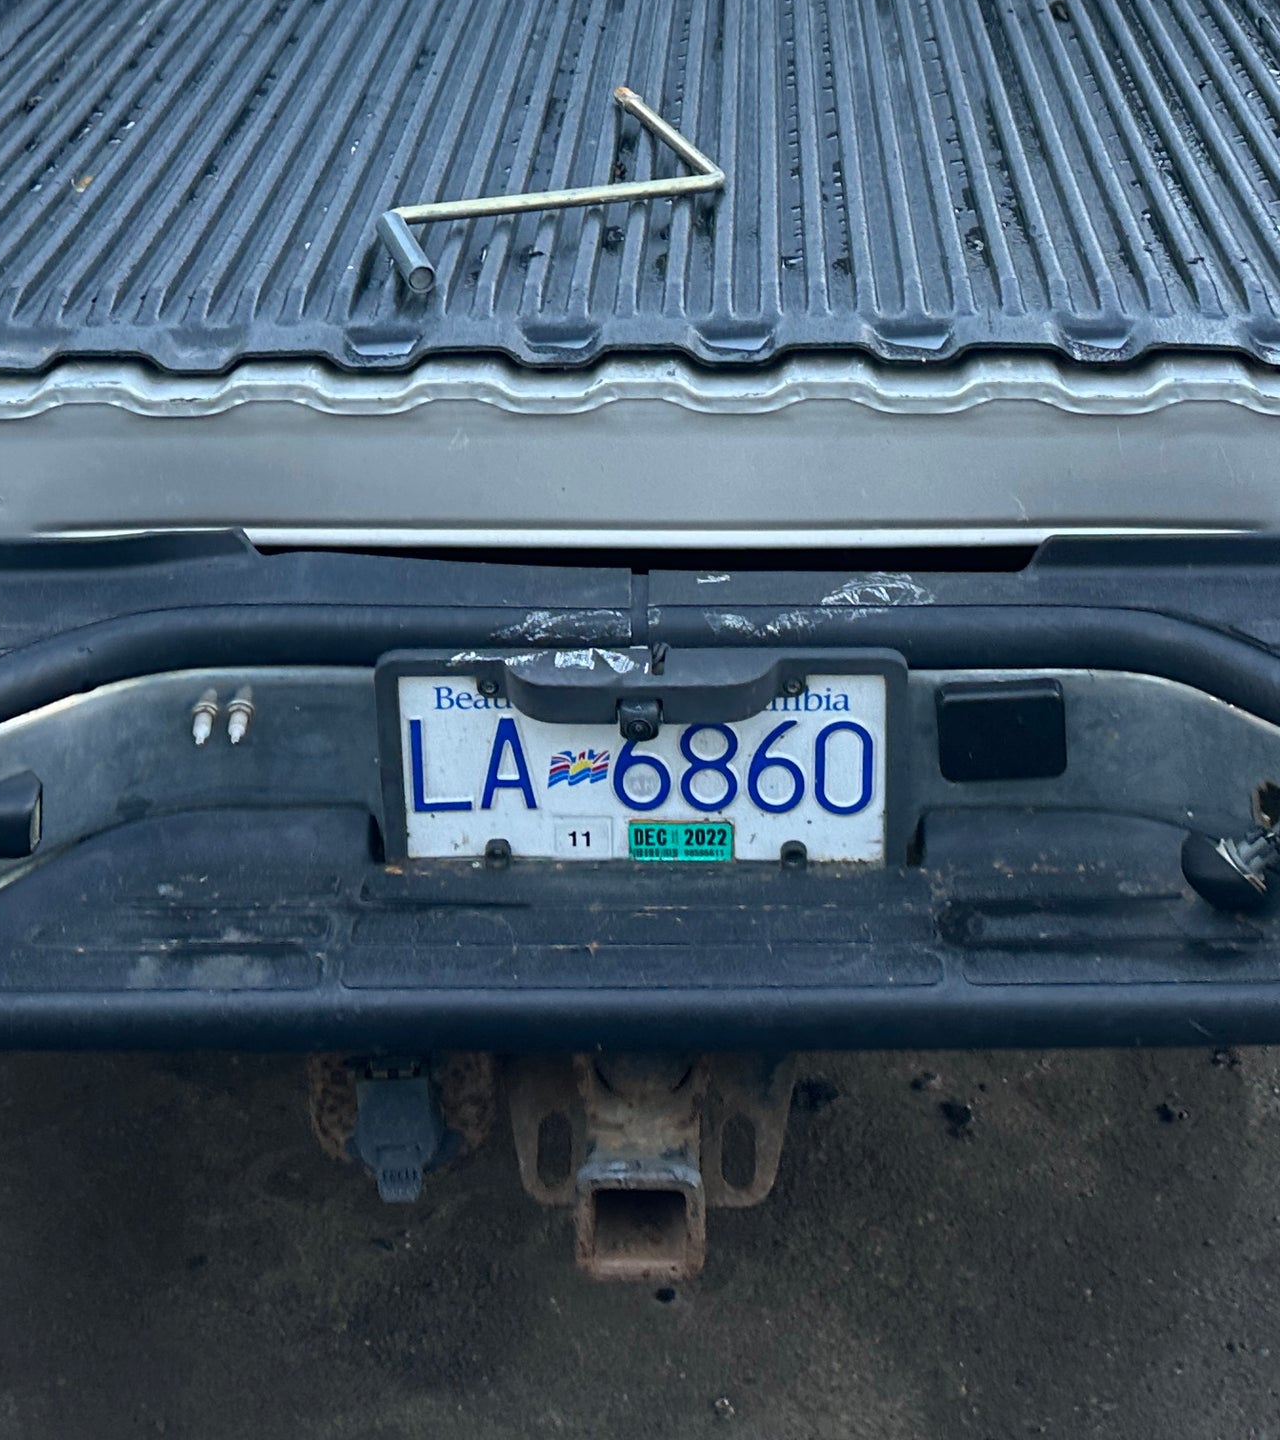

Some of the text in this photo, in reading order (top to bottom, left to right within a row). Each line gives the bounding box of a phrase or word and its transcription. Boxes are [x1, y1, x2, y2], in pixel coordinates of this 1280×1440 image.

[409, 717, 875, 816] LA 6860
[568, 830, 591, 847] 11
[633, 827, 728, 847] DEC 2022
